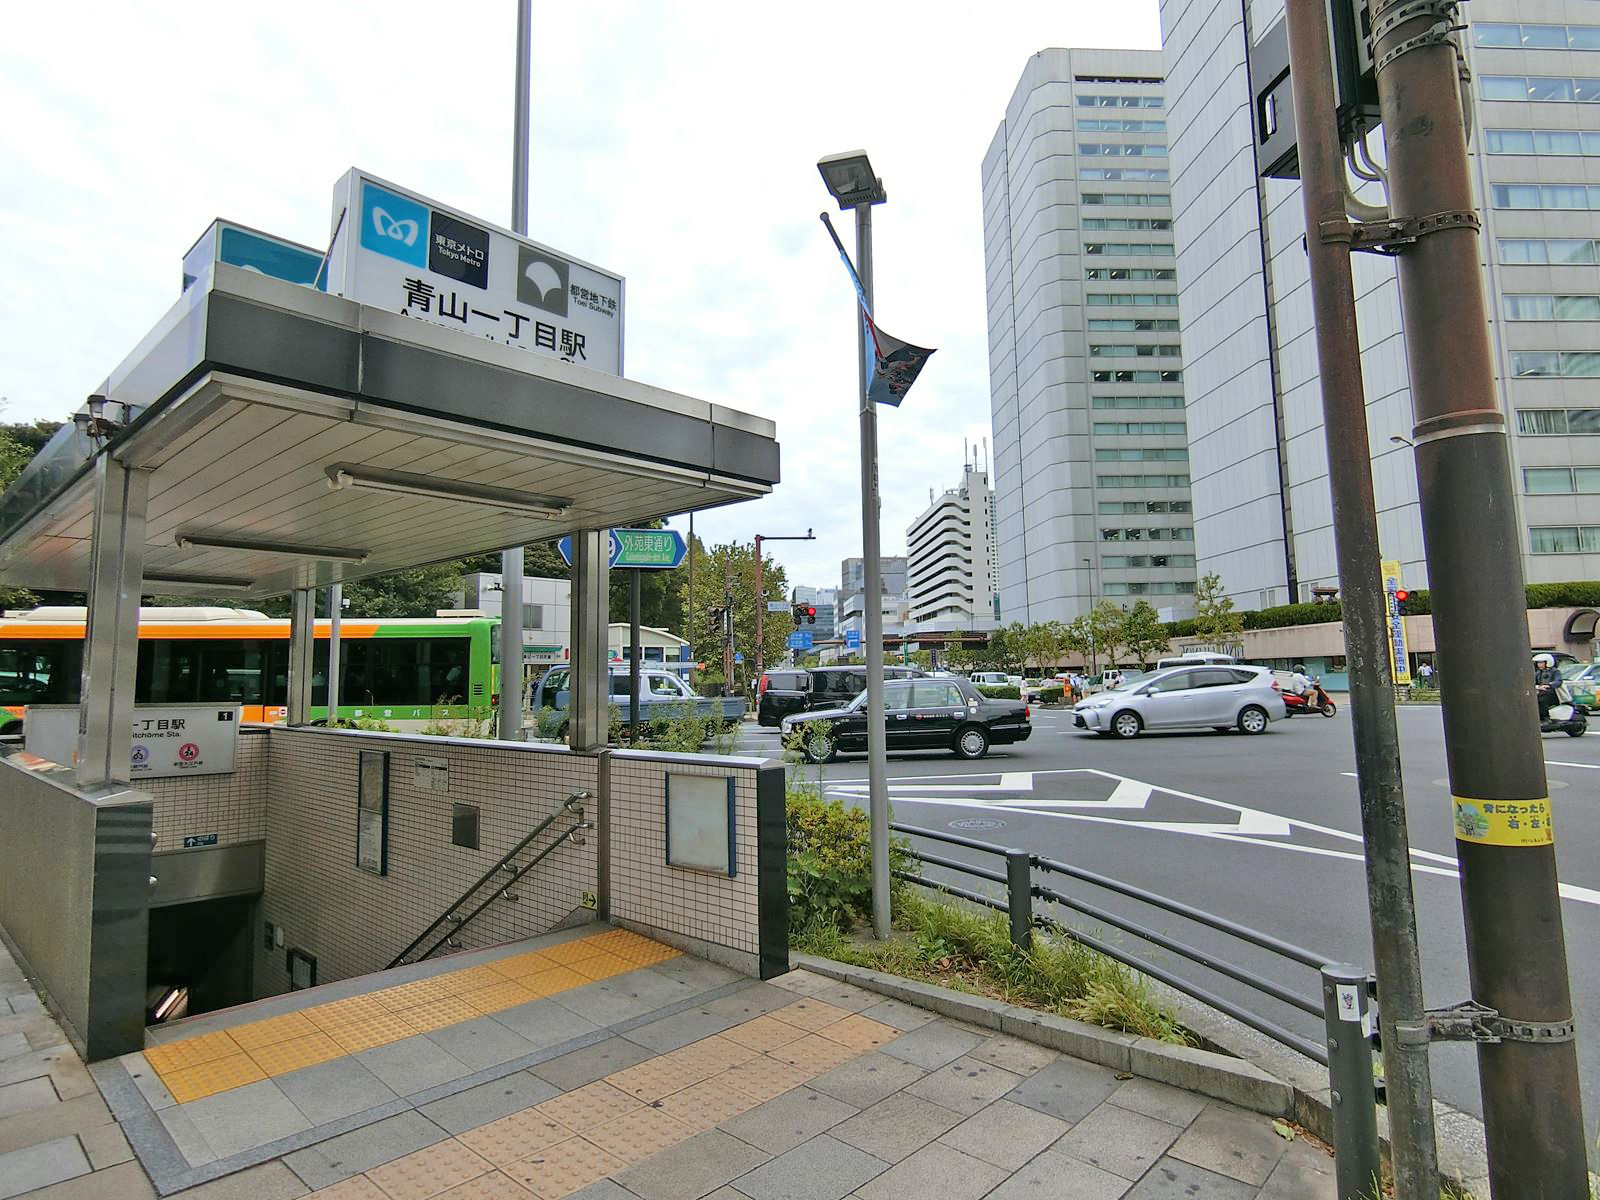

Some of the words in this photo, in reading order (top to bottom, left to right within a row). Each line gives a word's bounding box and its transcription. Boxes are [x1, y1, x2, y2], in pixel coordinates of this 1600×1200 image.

[434, 234, 485, 261] 東京メトロ
[438, 246, 460, 261] Tokyo
[459, 252, 482, 268] Metro
[570, 284, 618, 312] 都営地下鉄
[573, 298, 588, 310] Toei
[588, 303, 614, 319] Subway
[402, 277, 587, 361] 青山一丁目駅
[624, 535, 673, 552] 外苑東通り
